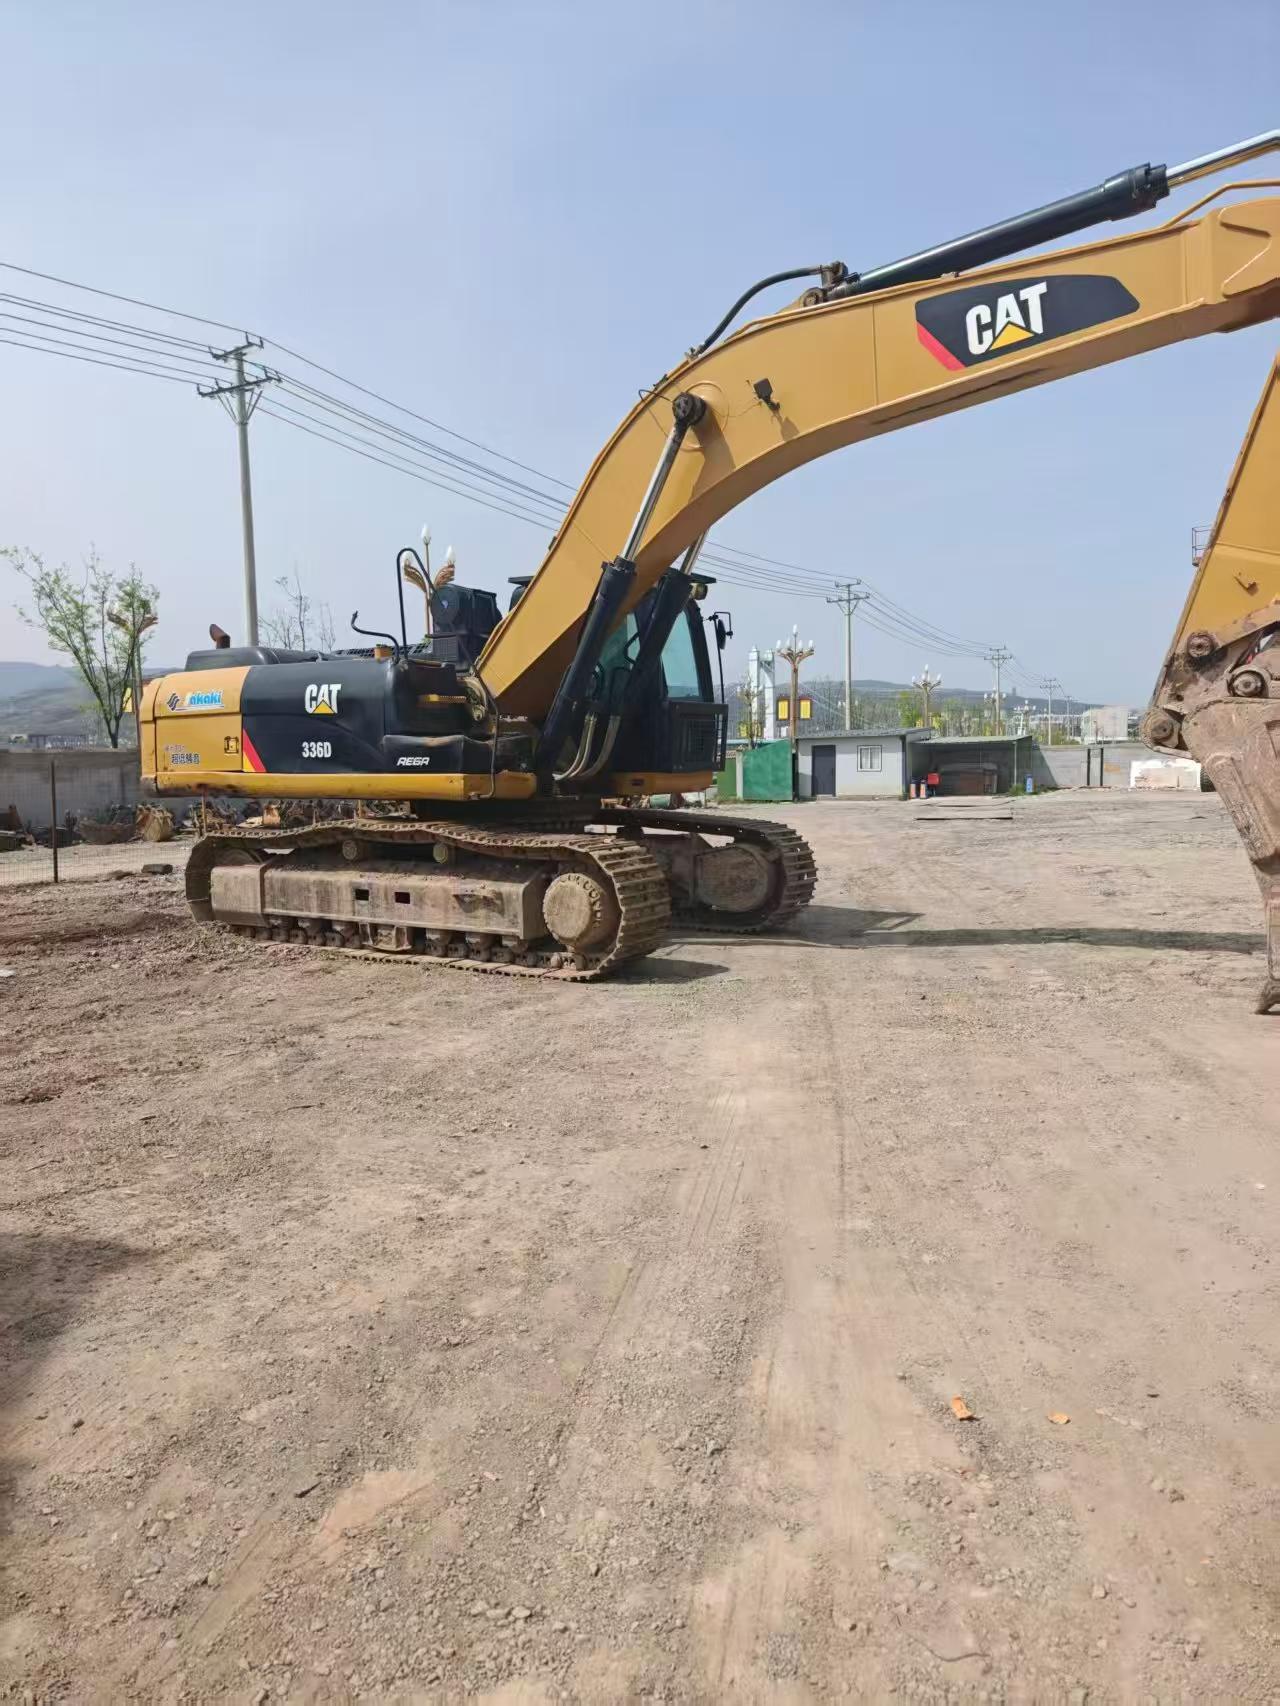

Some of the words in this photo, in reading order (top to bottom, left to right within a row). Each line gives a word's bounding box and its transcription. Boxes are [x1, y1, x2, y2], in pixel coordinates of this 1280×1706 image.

[966, 281, 1048, 355] CAT
[305, 684, 341, 714] CAT
[302, 741, 332, 758] 336D
